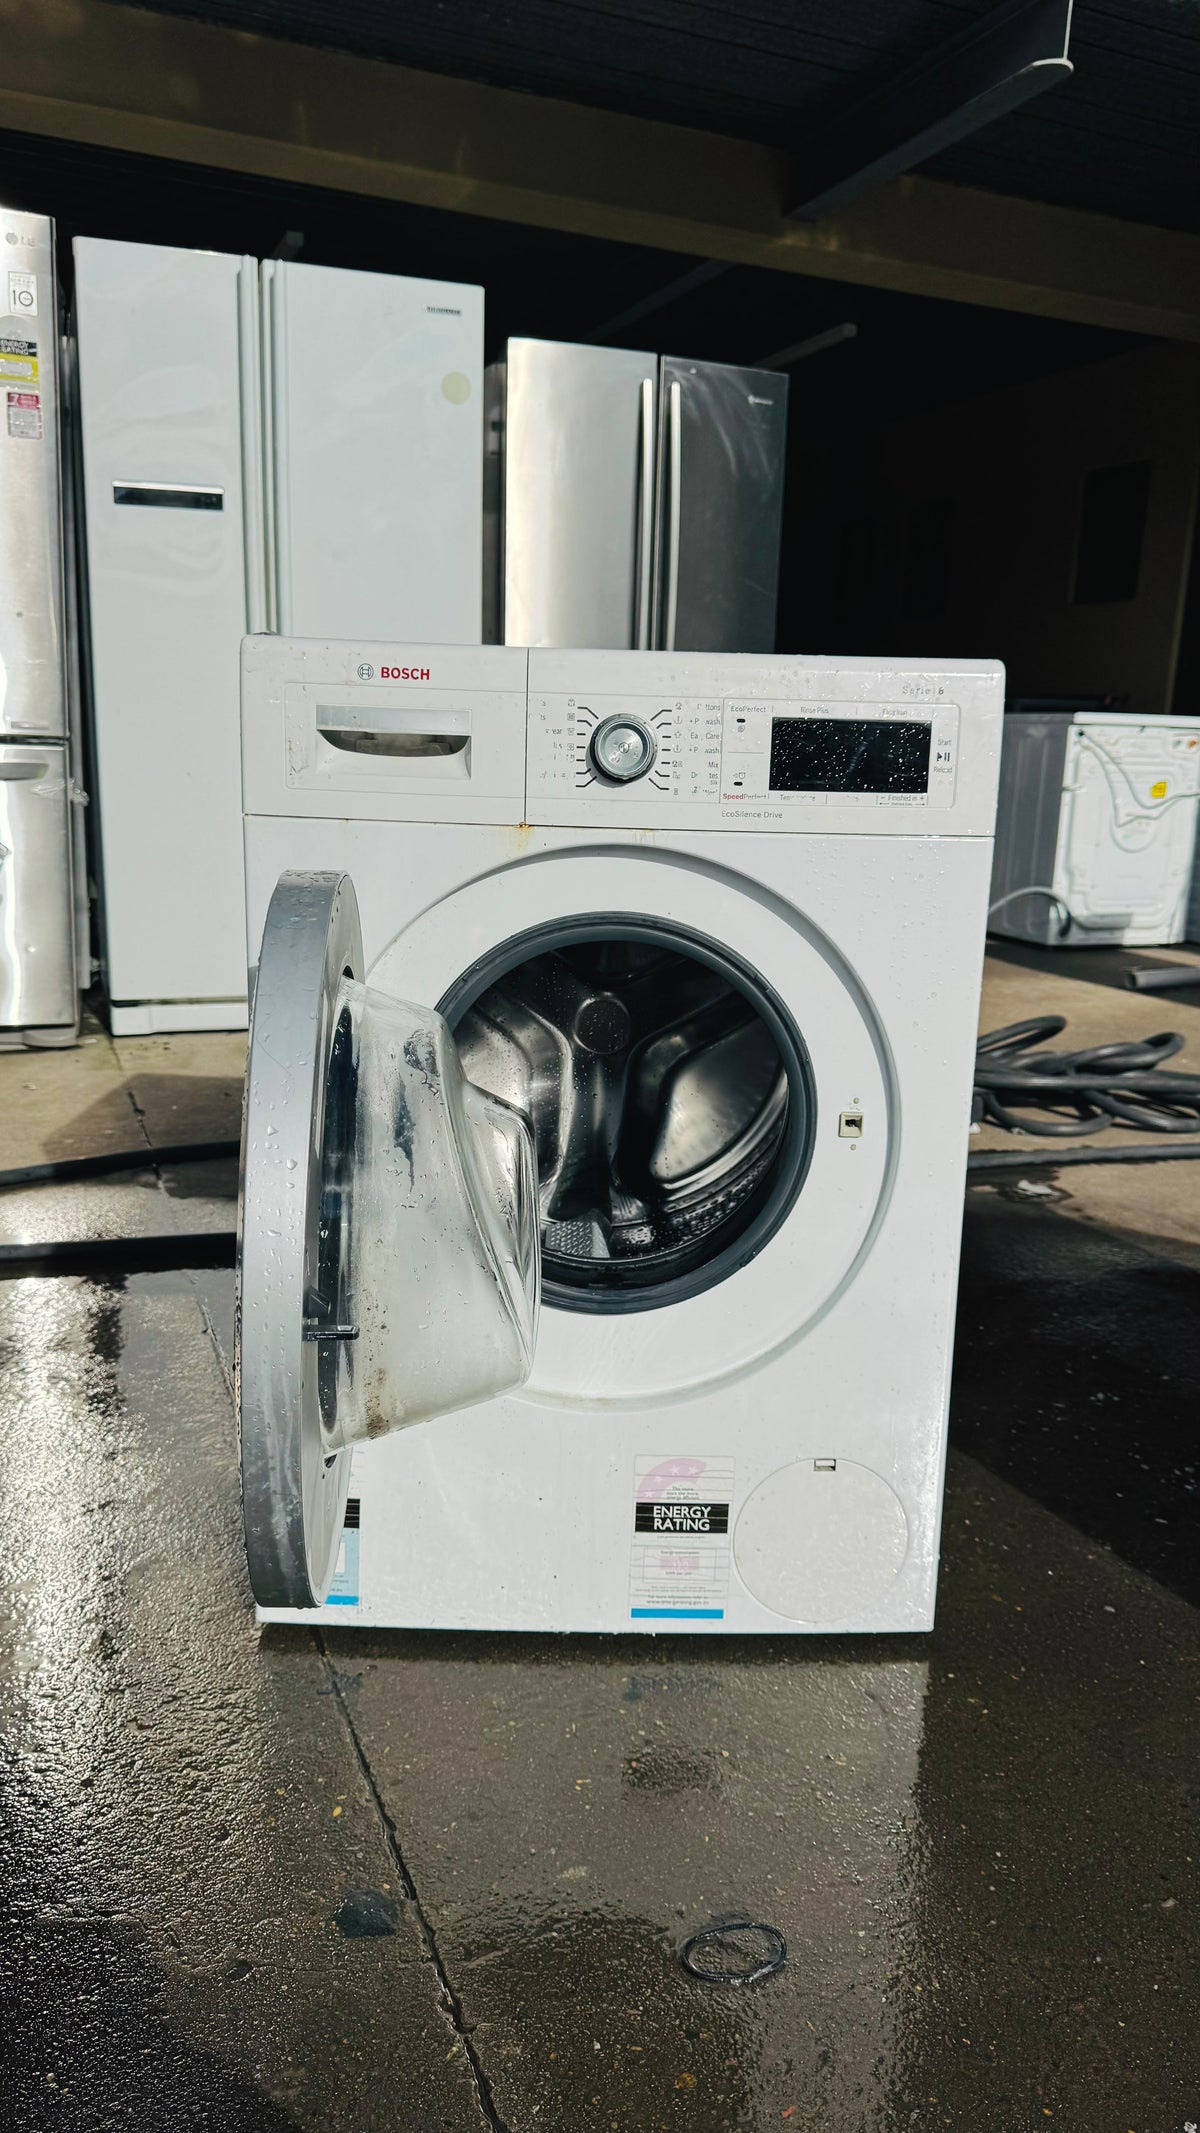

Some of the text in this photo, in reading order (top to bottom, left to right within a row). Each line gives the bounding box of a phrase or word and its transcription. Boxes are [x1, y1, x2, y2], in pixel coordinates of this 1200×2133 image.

[381, 667, 430, 680] BOSCH
[731, 705, 766, 713] EcoPerfect
[653, 1505, 711, 1518] ENERGY
[654, 1518, 710, 1531] RATING
